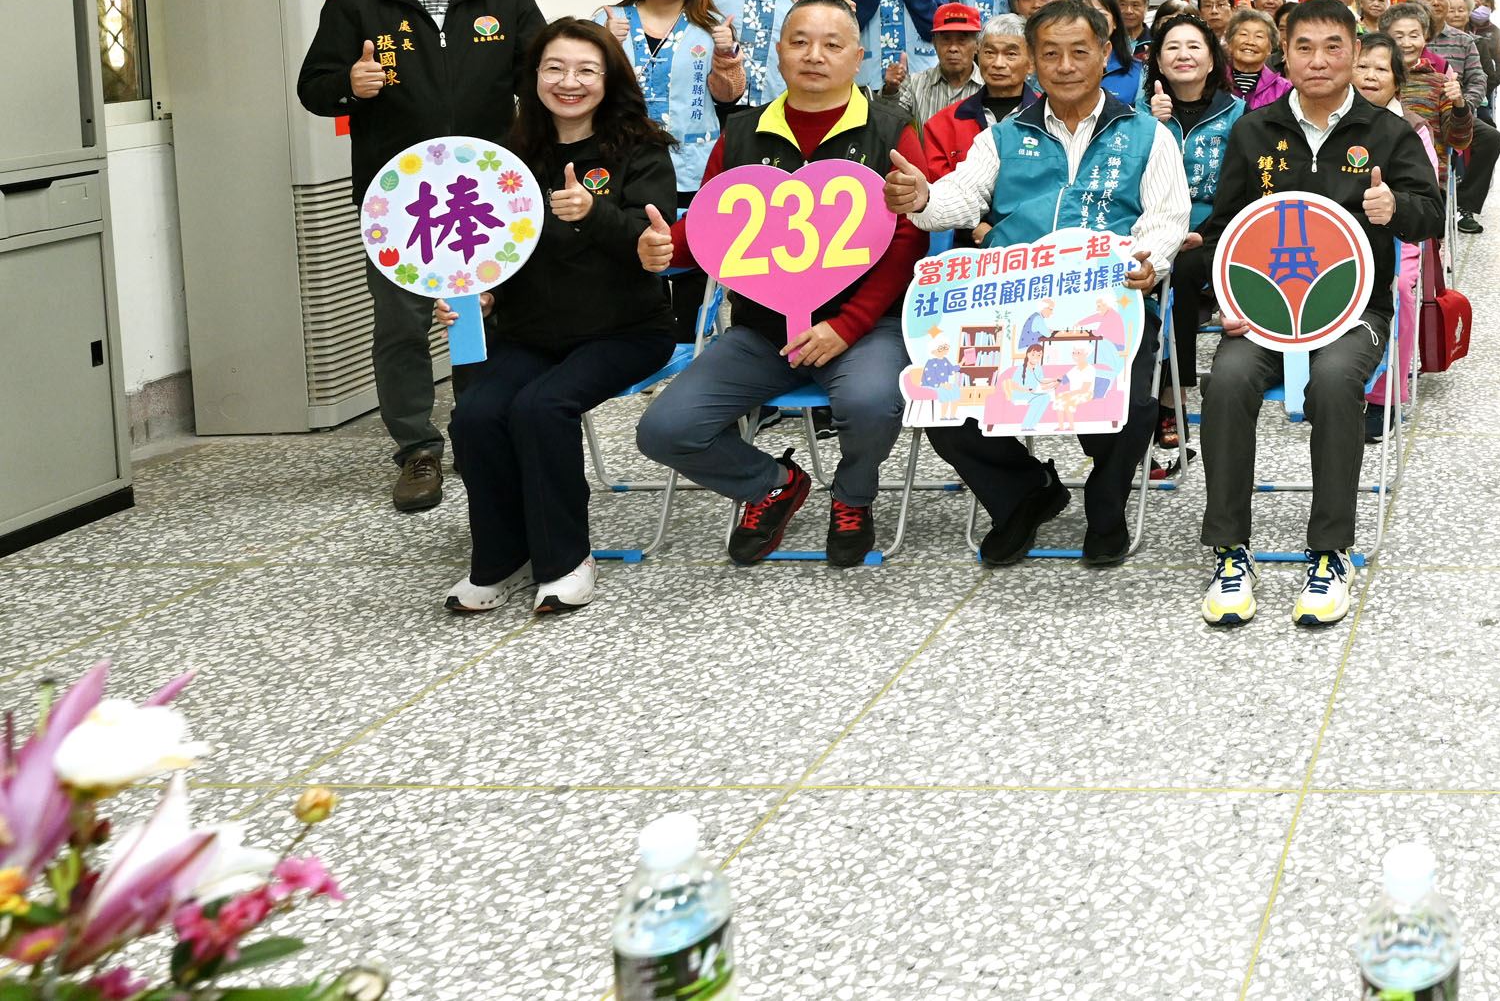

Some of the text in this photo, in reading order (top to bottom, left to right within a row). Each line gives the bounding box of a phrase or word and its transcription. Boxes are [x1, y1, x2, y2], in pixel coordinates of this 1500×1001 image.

[398, 19, 415, 51] 處長
[690, 59, 705, 120] 苗栗縣政府
[1276, 138, 1290, 171] 縣長
[405, 174, 505, 265] 棒
[717, 175, 870, 278] 232
[913, 262, 1137, 317] 社區照顧關懷據點
